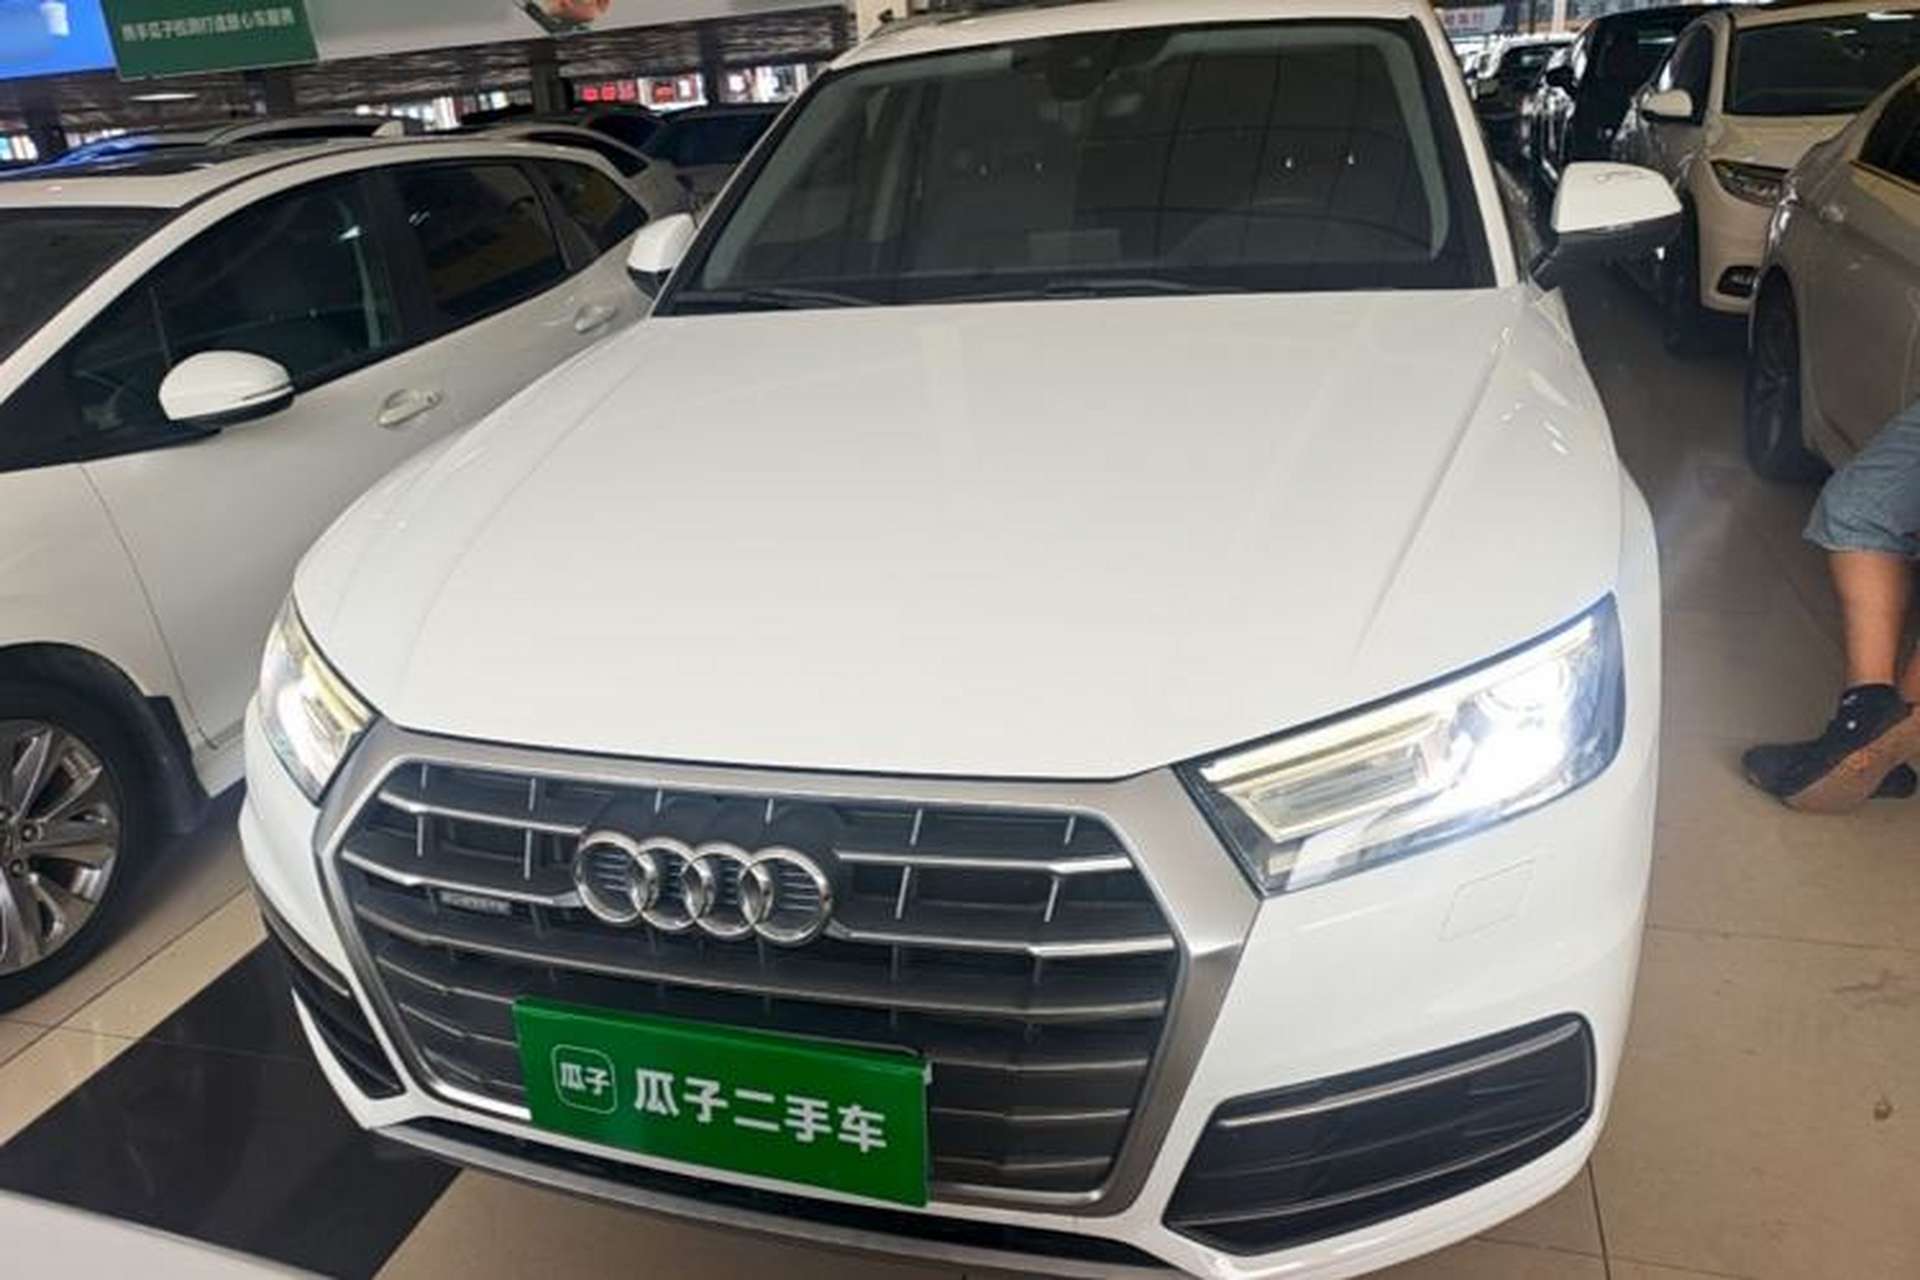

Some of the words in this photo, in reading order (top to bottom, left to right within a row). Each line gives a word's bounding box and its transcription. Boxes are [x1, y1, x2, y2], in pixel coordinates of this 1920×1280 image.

[559, 1061, 610, 1096] 瓜子
[634, 1067, 888, 1154] 瓜子二手车
